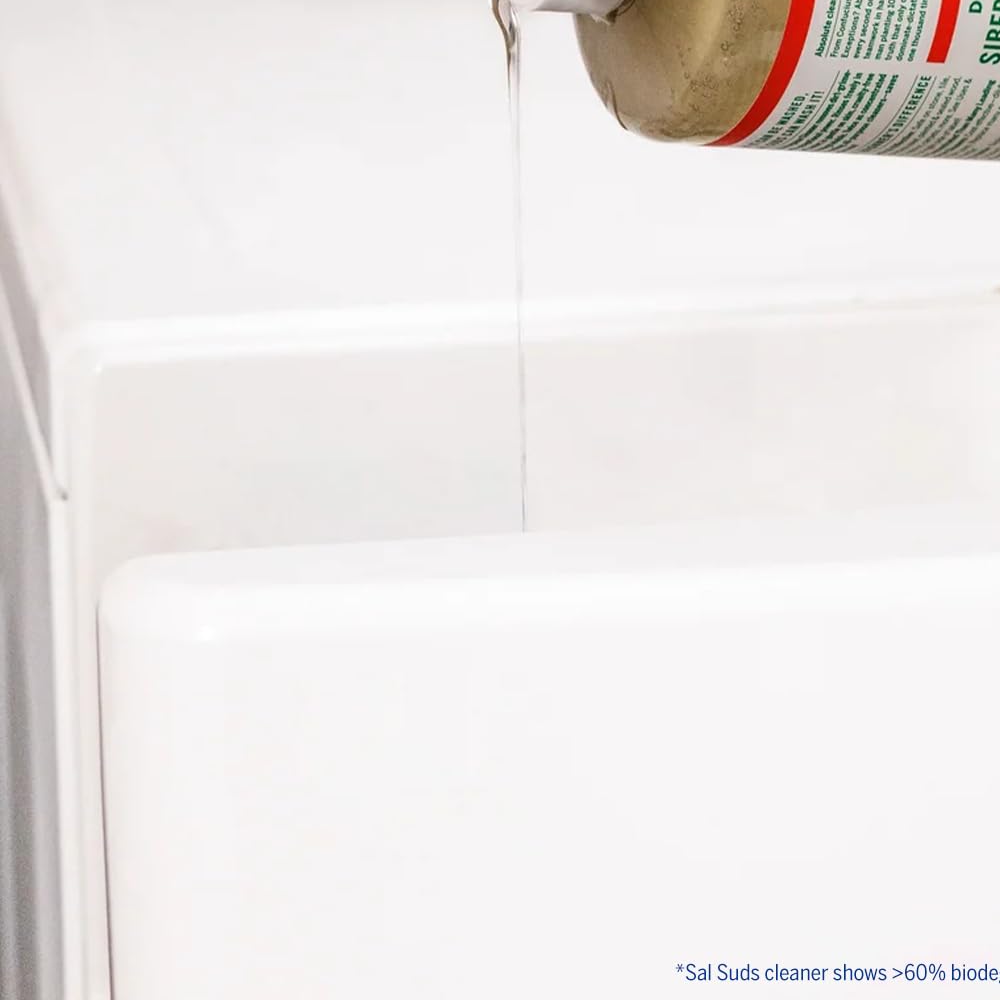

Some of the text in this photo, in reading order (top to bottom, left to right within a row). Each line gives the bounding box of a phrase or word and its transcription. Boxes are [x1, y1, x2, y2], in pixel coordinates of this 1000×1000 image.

[858, 8, 871, 36] second
[878, 10, 894, 41] planting
[894, 5, 906, 21] only
[814, 20, 832, 56] Absolute
[841, 11, 862, 57] Exceptions?
[862, 22, 879, 59] teamwork
[889, 24, 900, 39] that
[909, 10, 925, 46] thousand
[830, 38, 842, 57] From
[853, 39, 866, 58] every
[874, 44, 884, 59] man
[883, 41, 896, 60] truth
[906, 48, 915, 61] one
[860, 73, 886, 114] concentrated
[892, 75, 931, 127] DIFFERENCE
[976, 79, 996, 106] Leading
[793, 104, 819, 124] WASH
[809, 90, 824, 102] IT!
